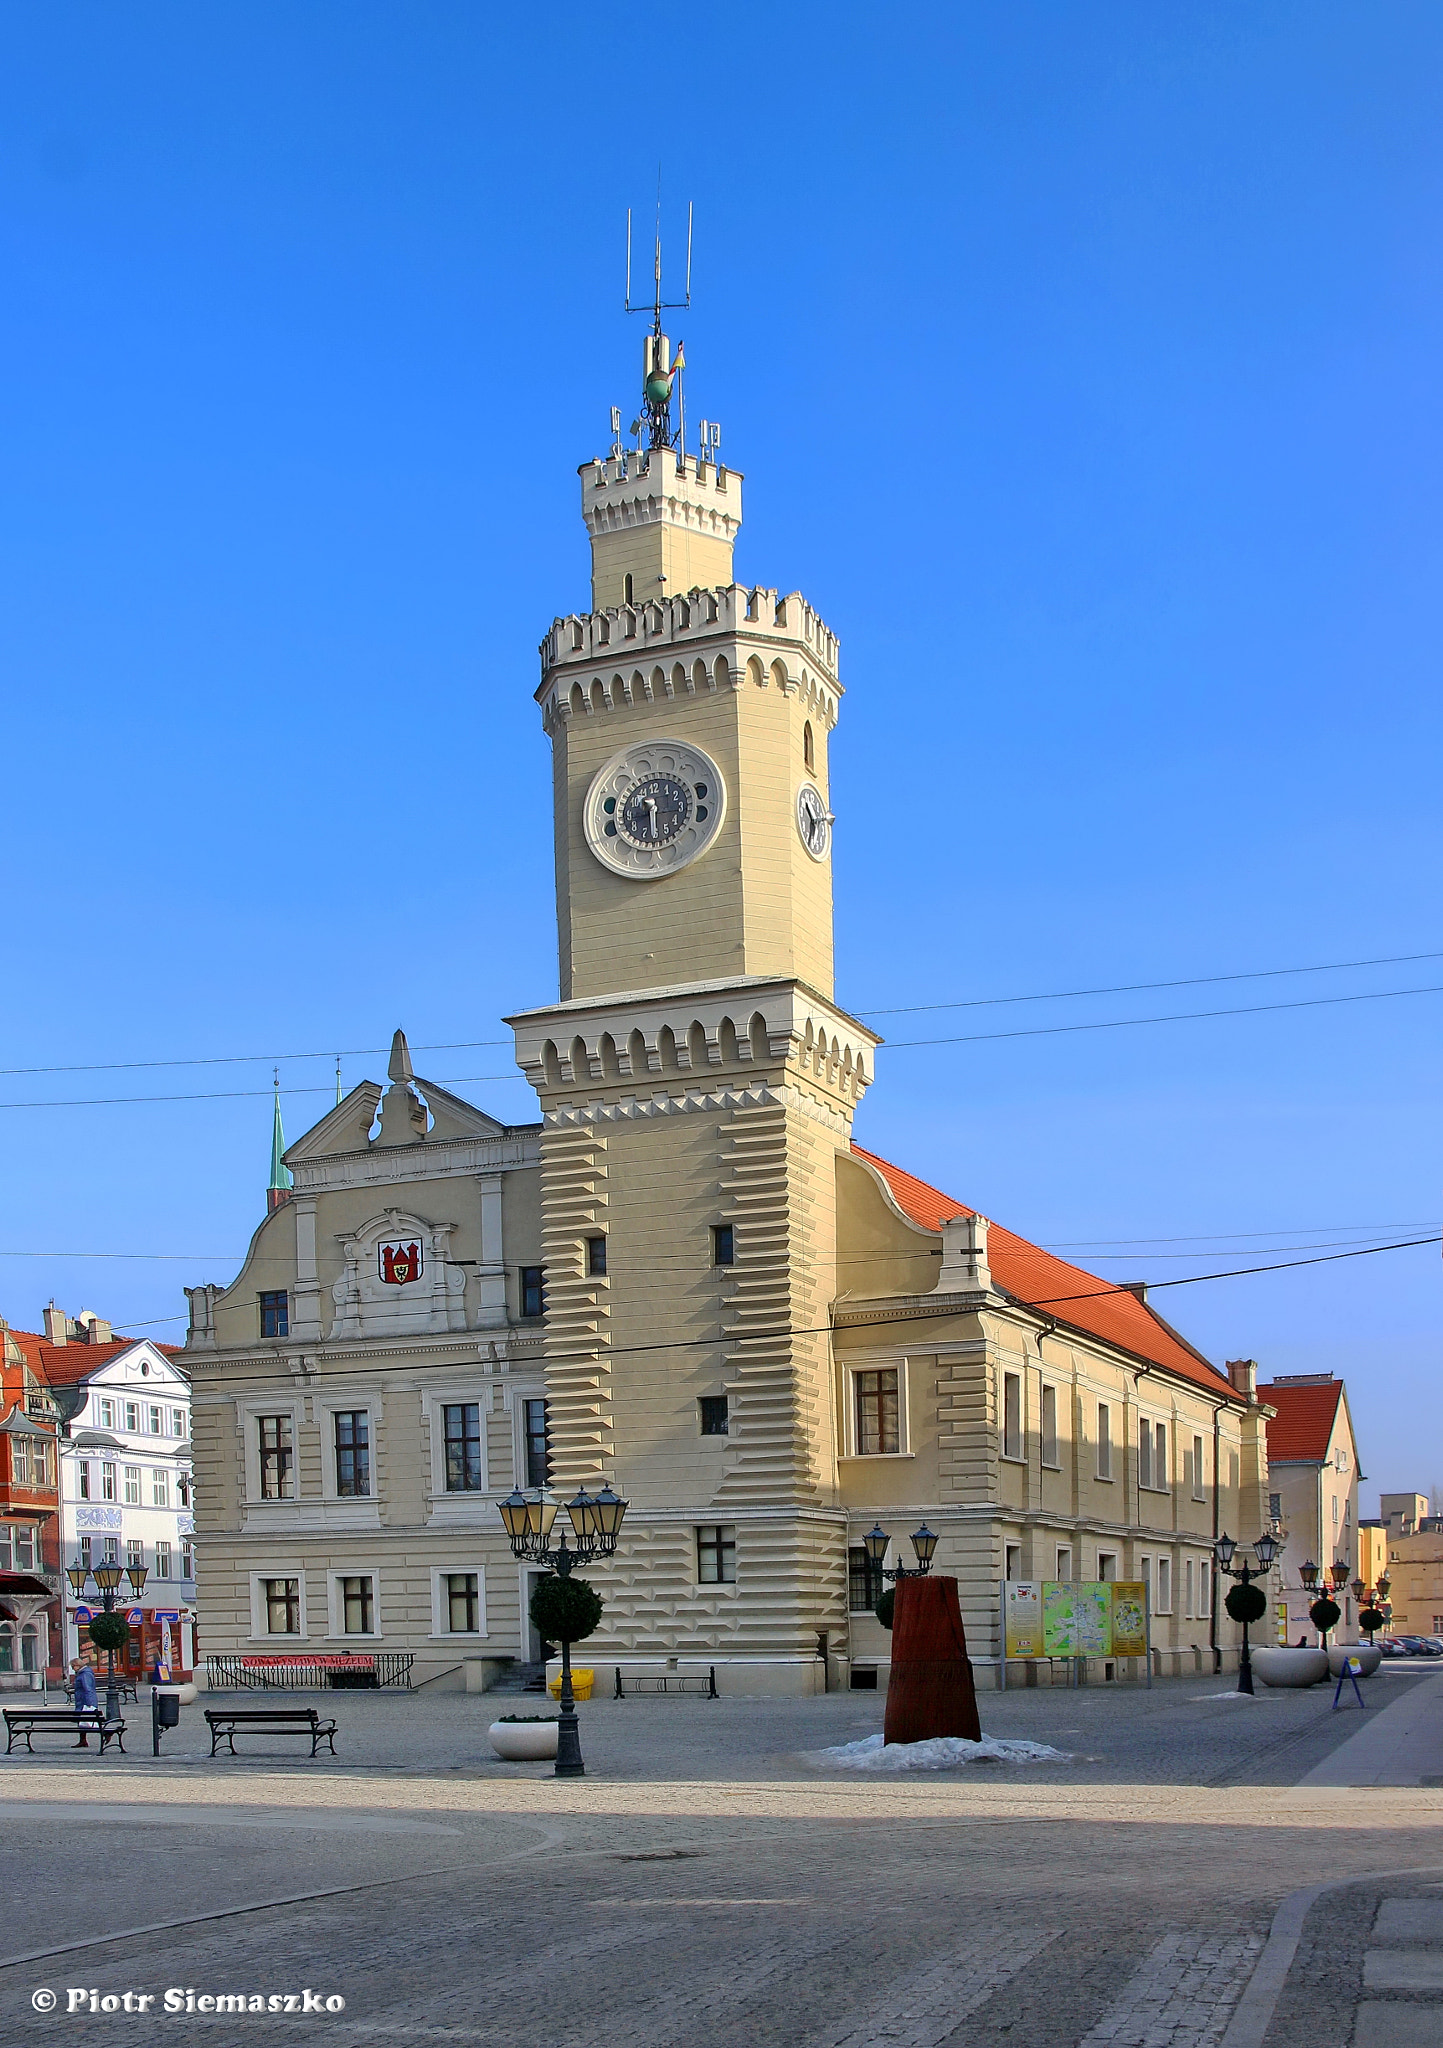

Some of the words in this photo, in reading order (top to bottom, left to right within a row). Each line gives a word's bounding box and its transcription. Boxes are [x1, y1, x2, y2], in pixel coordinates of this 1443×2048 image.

[649, 783, 659, 794] 12
[664, 785, 669, 795] 1
[673, 791, 679, 800] 2
[631, 797, 639, 807] 10
[678, 802, 683, 812] 3
[627, 810, 632, 820] 9
[672, 815, 677, 825] 4
[632, 821, 637, 831] 8
[664, 824, 669, 834] 5
[643, 828, 647, 838] 7
[243, 1658, 270, 1666] NOWA
[272, 1657, 317, 1666] WYSTAWA
[318, 1657, 327, 1665] W
[330, 1656, 373, 1666] MUZEUM
